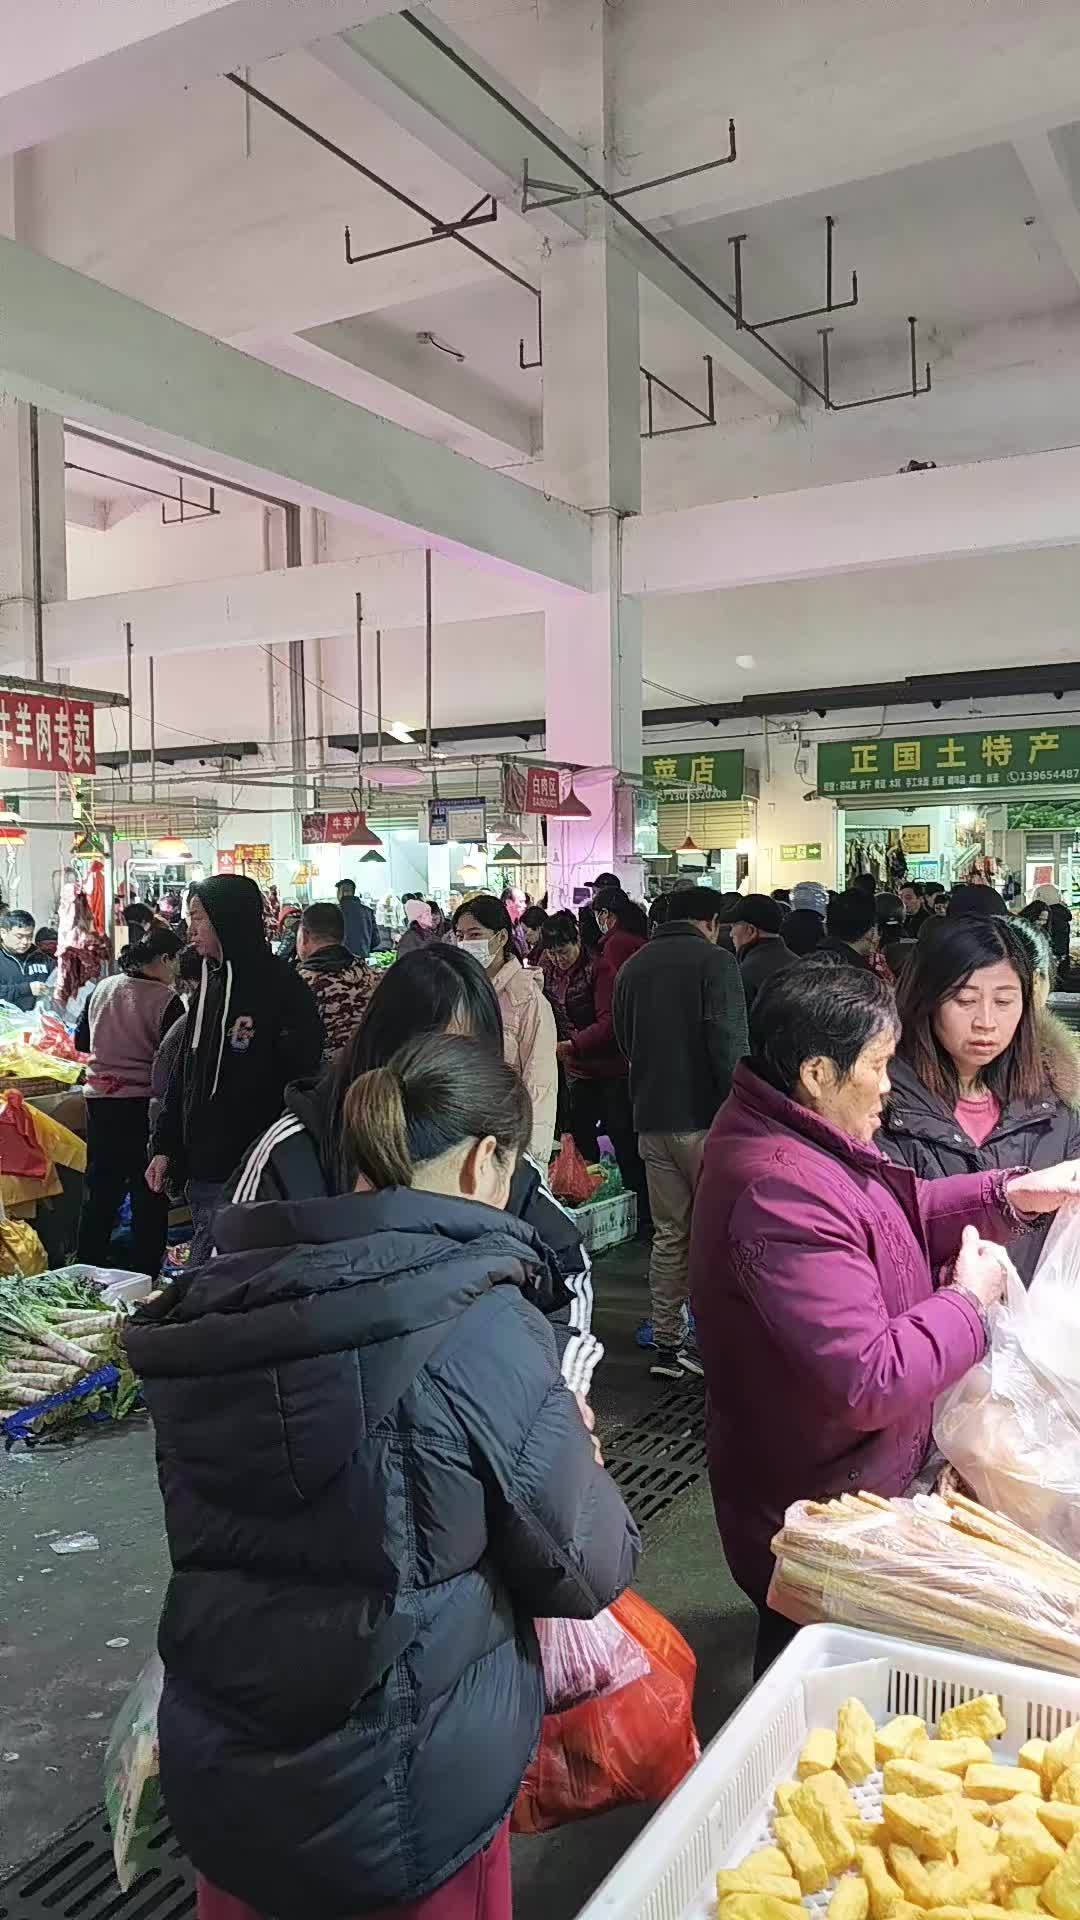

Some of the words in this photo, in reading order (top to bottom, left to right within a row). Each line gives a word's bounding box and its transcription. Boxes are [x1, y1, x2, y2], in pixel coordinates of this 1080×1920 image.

[849, 731, 1060, 774] 正国土特产
[1020, 768, 1079, 782] 139654487
